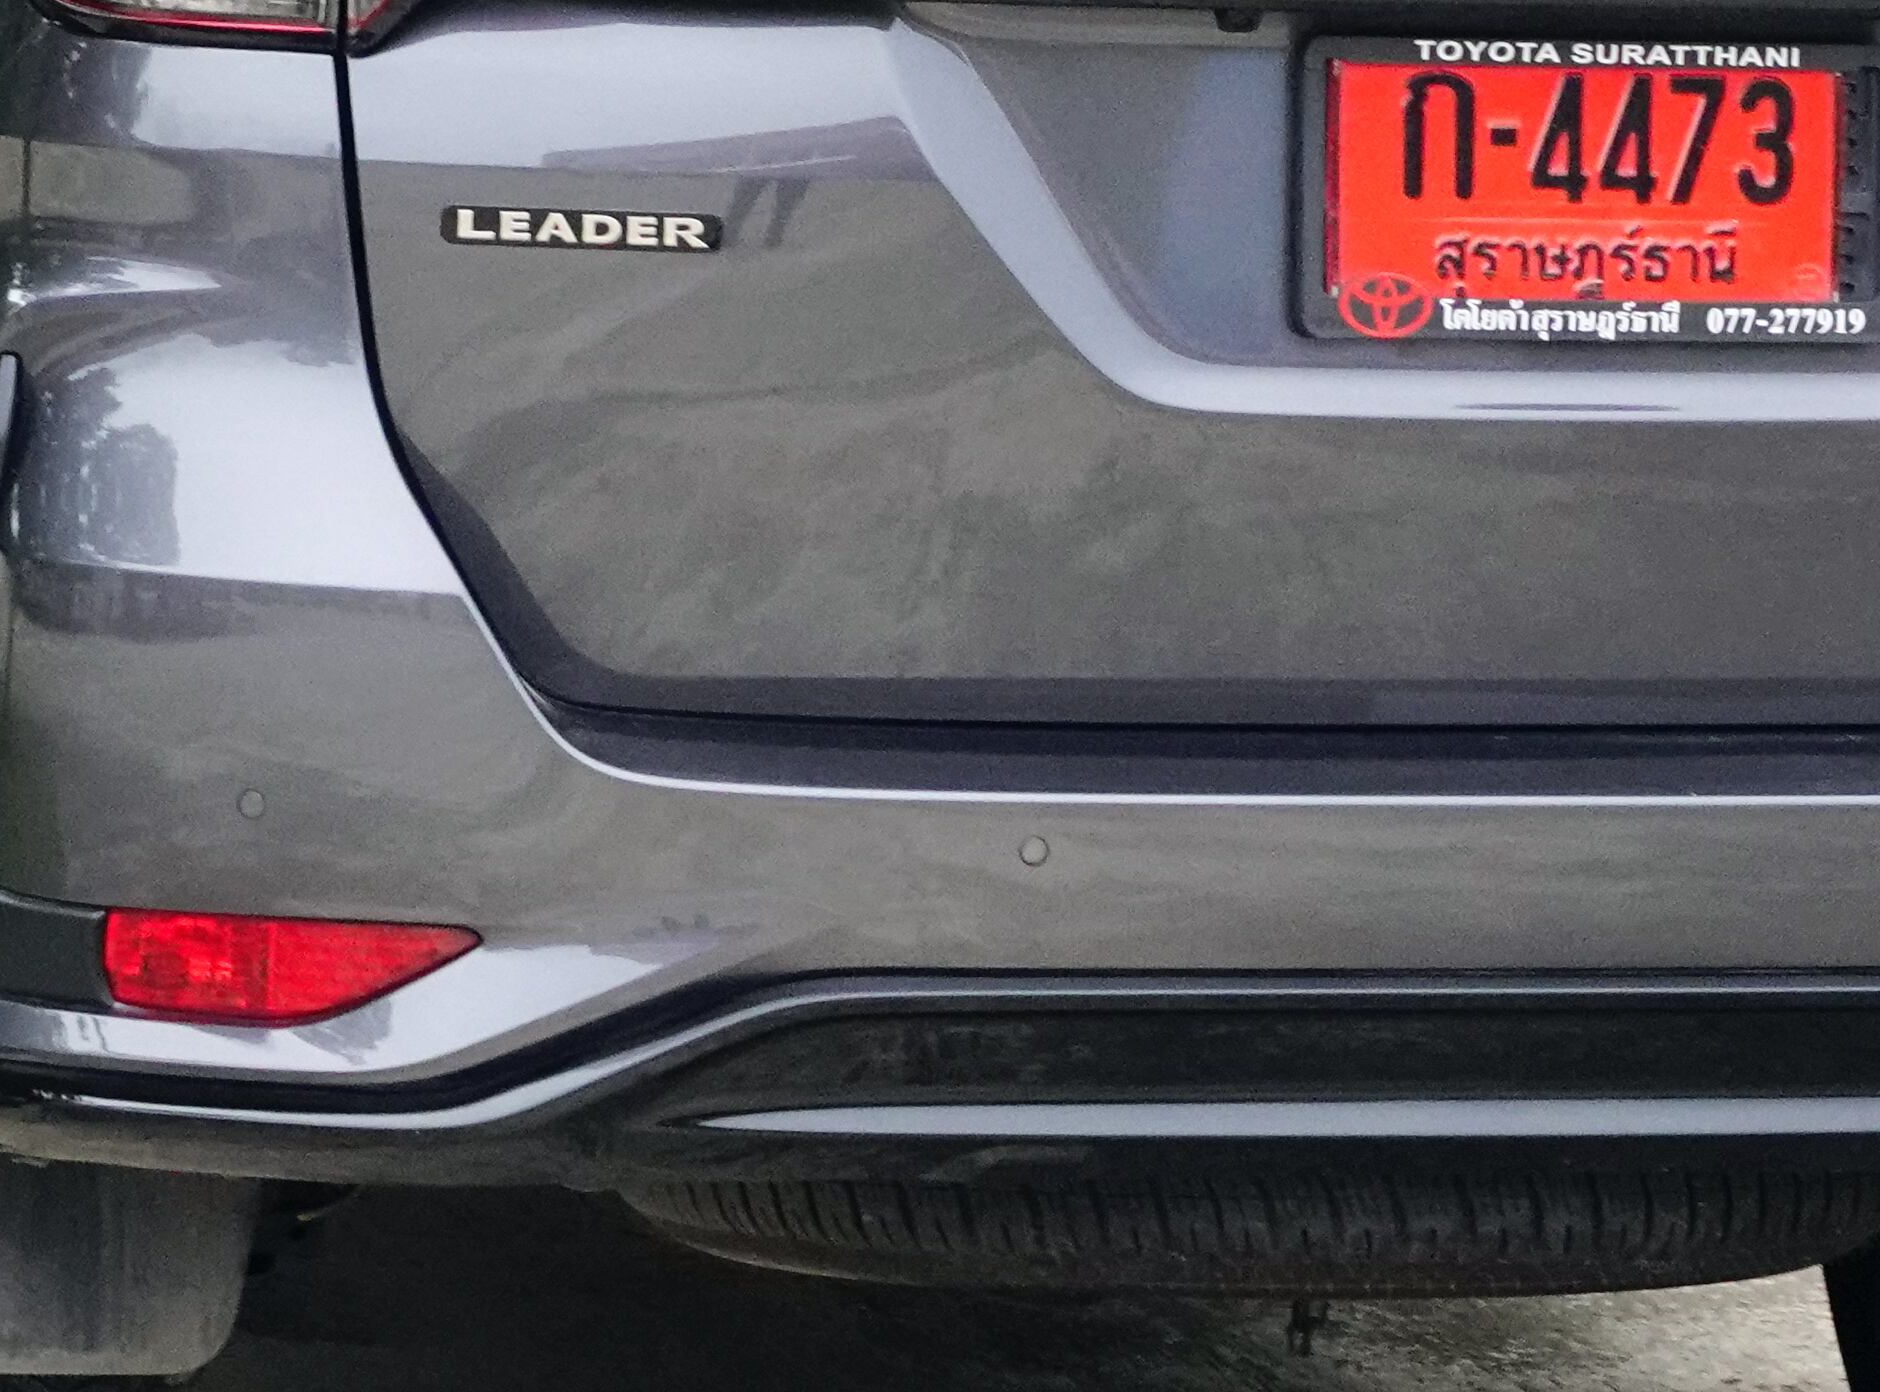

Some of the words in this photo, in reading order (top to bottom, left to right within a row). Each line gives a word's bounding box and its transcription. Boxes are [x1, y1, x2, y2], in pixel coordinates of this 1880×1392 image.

[1413, 38, 1562, 64] TOYOTA
[1570, 42, 1802, 68] SURATTHANI
[1402, 70, 1797, 205] ก-4473
[456, 208, 710, 249] LEADER
[1706, 306, 1867, 335] 077-277919
